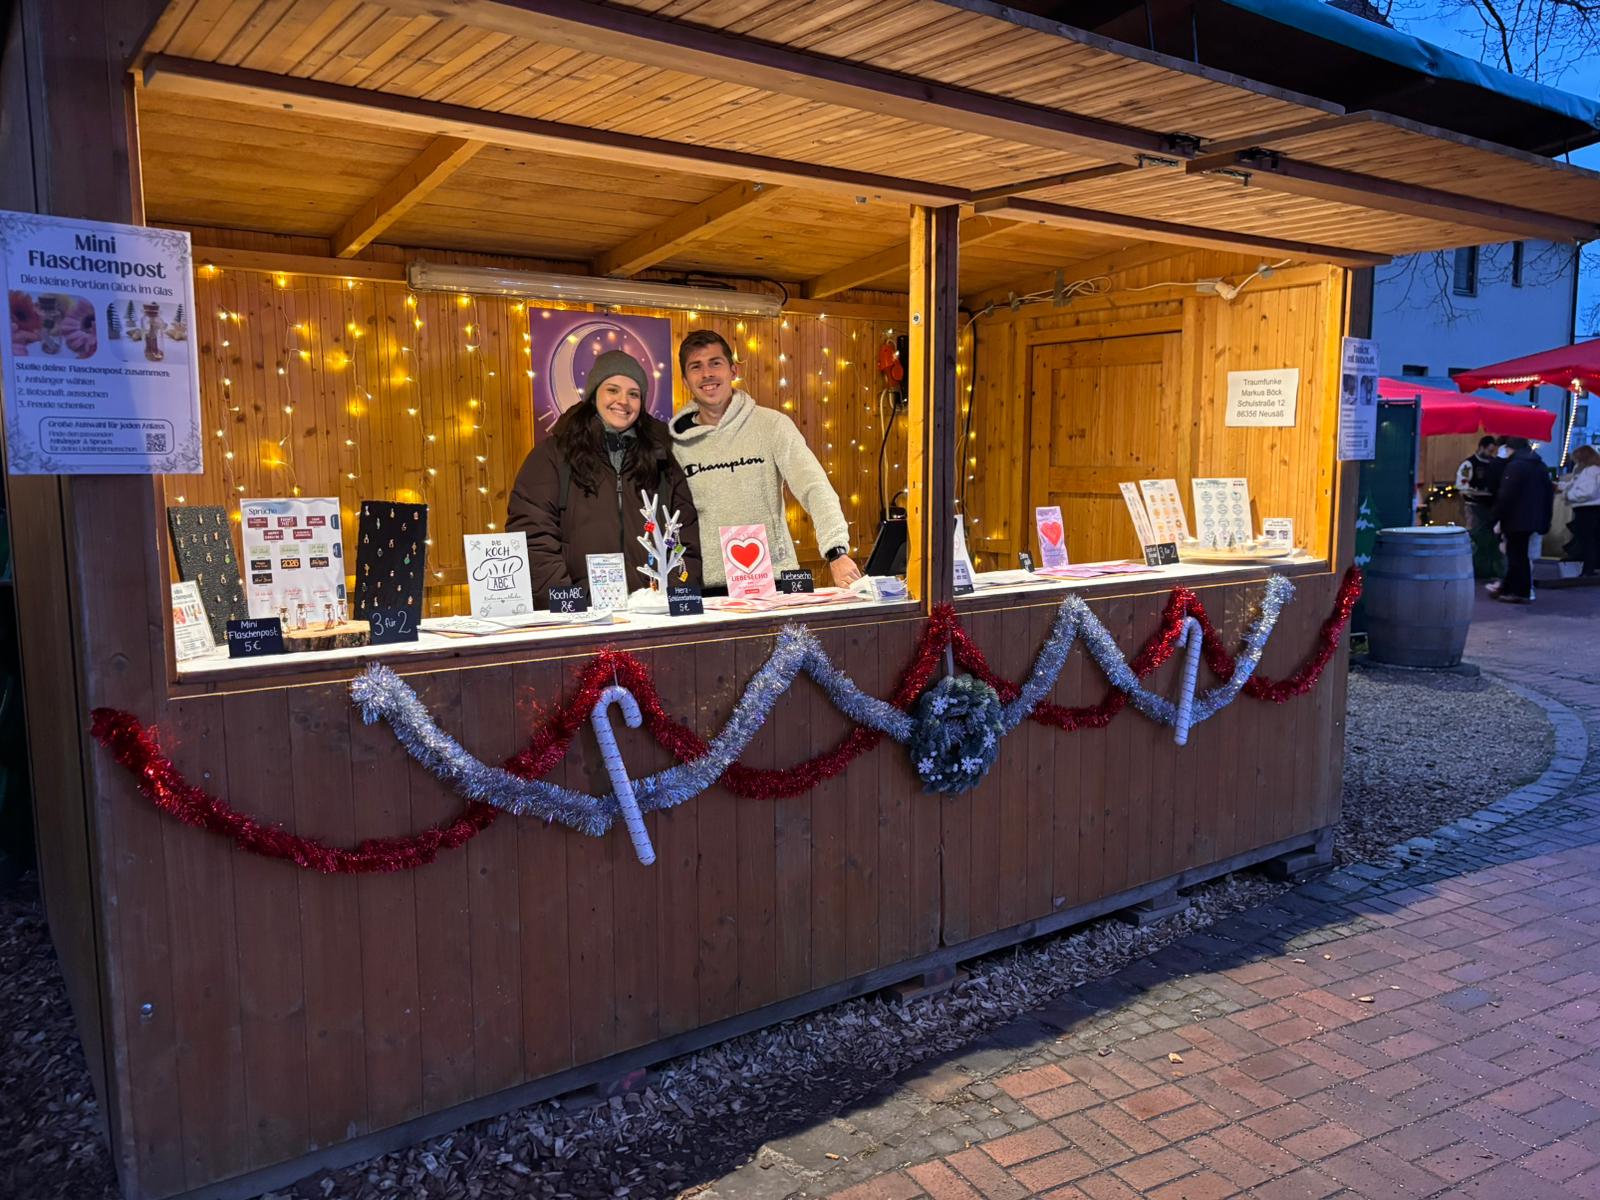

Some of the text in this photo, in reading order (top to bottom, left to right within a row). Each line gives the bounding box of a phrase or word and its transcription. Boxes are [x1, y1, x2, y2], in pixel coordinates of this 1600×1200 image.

[75, 234, 116, 254] Mini
[28, 249, 167, 279] Flaschenpost
[20, 273, 173, 297] Die kleine Portion Glück im Glas
[69, 365, 122, 376] Flaschenpost
[25, 375, 64, 386] Anhänger
[1242, 378, 1282, 386] Traumfunke
[1241, 388, 1282, 397] Markus Böck
[27, 400, 55, 409] Freude
[57, 402, 96, 410] schenken
[1237, 399, 1286, 407] Schulstraße 12
[683, 457, 765, 478] Champion
[485, 546, 510, 557] KOCH
[731, 572, 769, 582] LIEBESECHO
[782, 571, 812, 580] Liebesecho
[493, 577, 509, 589] ABC
[791, 581, 804, 592] 8€
[549, 587, 584, 600] Koch ABC
[560, 600, 576, 613] 8€
[241, 620, 258, 629] Mini
[372, 610, 412, 636] 3 für 2
[228, 626, 279, 640] Flaschenpost
